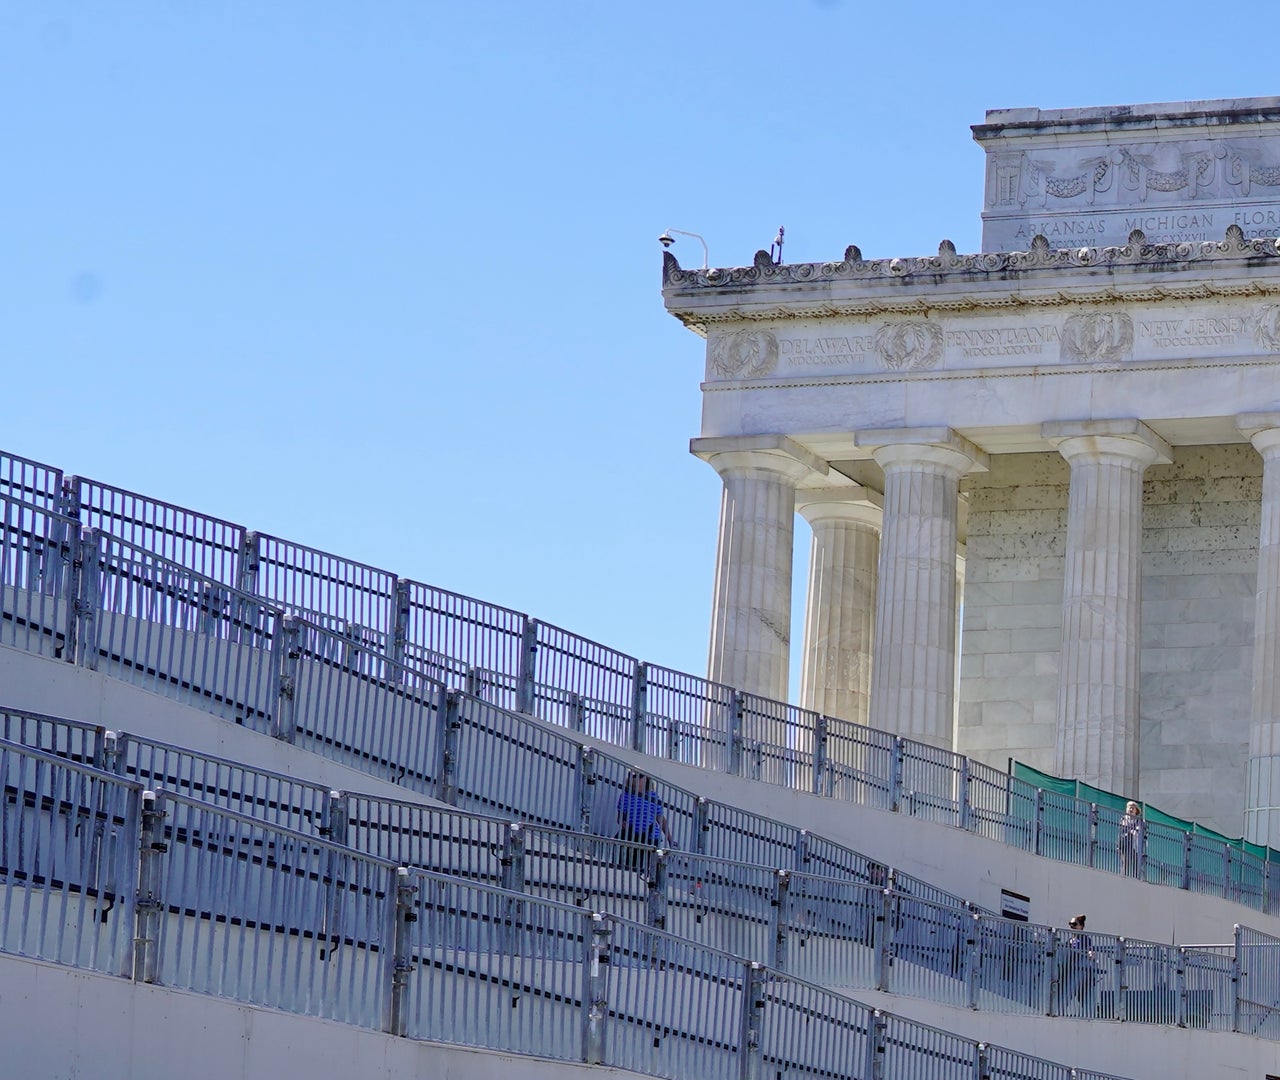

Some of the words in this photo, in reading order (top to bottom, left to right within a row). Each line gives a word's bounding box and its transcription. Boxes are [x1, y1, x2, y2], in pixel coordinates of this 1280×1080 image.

[1015, 220, 1106, 238] ARKANSAS
[1125, 214, 1213, 231] MICHIGAN
[1148, 233, 1206, 243] CCCXXXVII
[1140, 320, 1183, 337] NEW
[1185, 316, 1251, 334] JERSEY
[779, 336, 874, 354] DELAWARE
[944, 326, 1061, 347] PENNSYLVANIA
